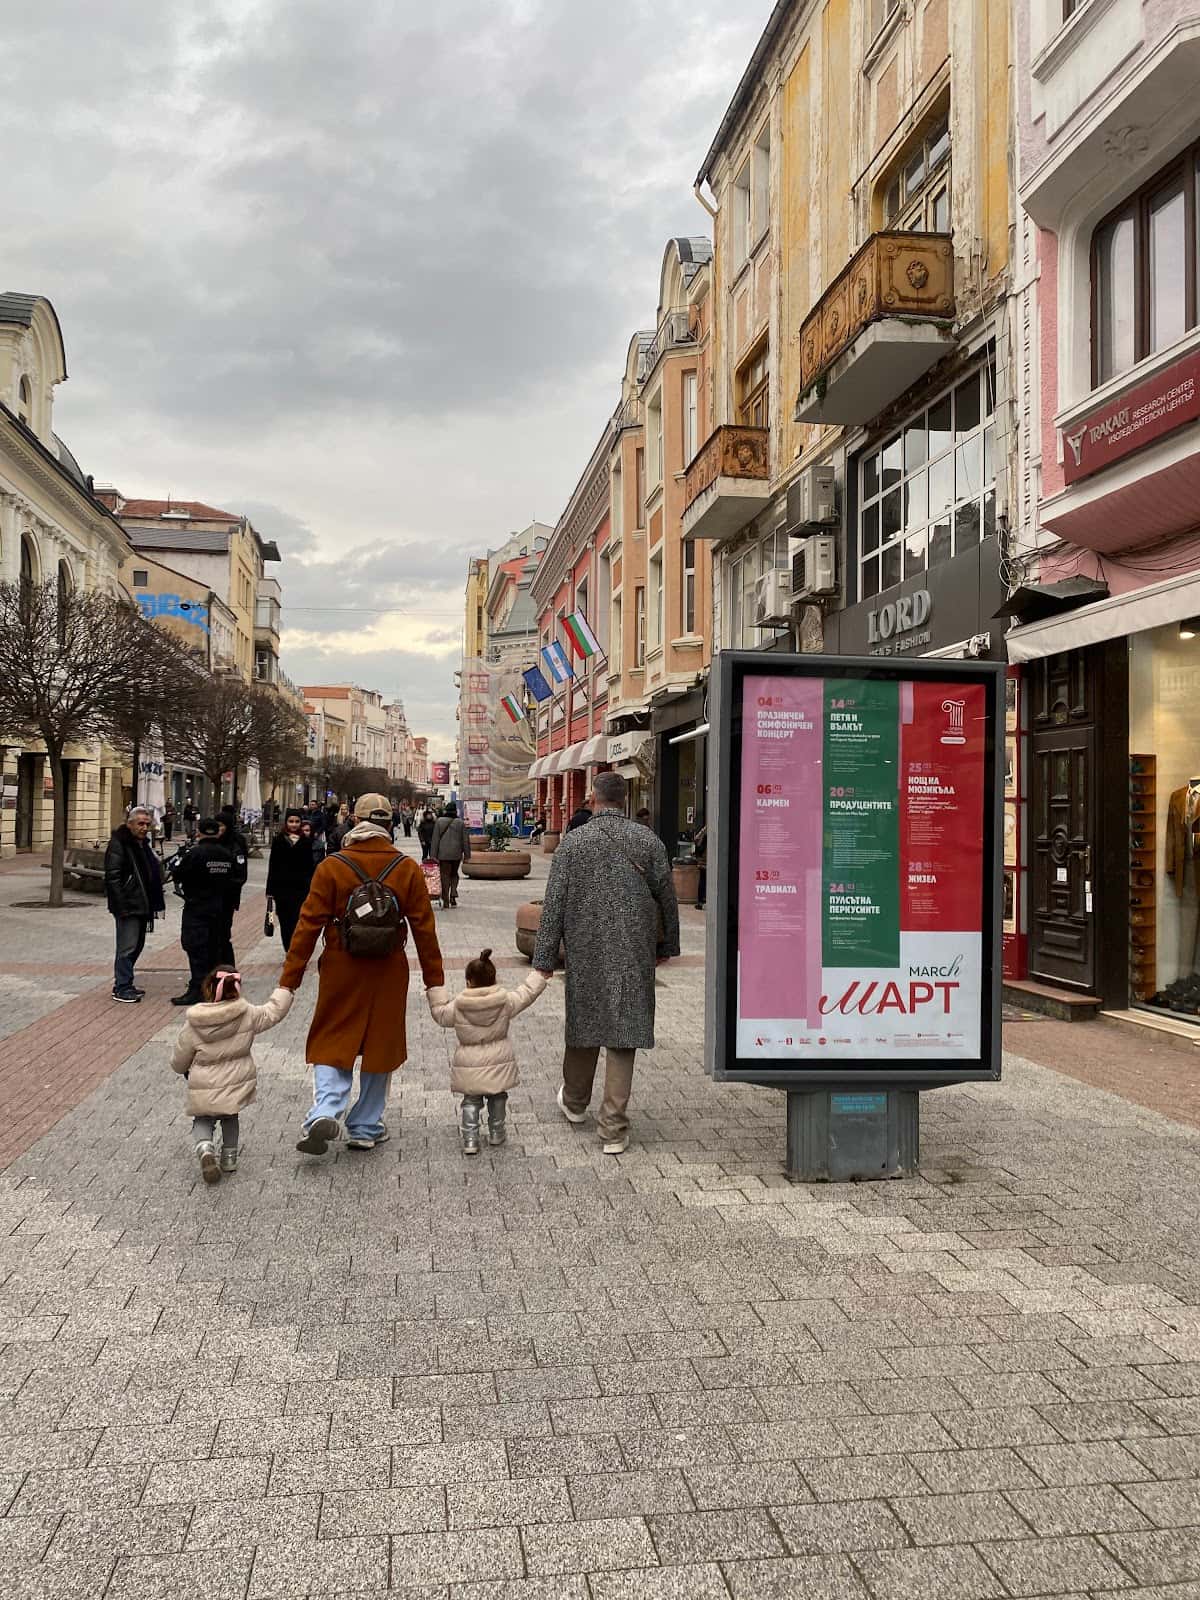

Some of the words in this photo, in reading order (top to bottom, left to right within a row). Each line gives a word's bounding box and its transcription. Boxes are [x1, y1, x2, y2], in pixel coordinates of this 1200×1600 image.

[1132, 394, 1167, 420] RESEARCH
[1166, 379, 1195, 400] CENTER
[1089, 407, 1130, 445] TRAKART
[868, 590, 931, 643] LORD
[895, 631, 931, 653] FASHION
[757, 697, 773, 706] 04
[831, 699, 845, 709] 14
[757, 711, 805, 720] ПРАЗНИЧЕН
[830, 713, 851, 721] ПЕТЯ
[830, 722, 864, 731] ВЪЛКЪТ
[757, 730, 794, 739] КОНЦЕРТ
[909, 763, 922, 773] 25
[908, 776, 927, 785] НОЩ
[757, 784, 772, 794] 06
[830, 787, 844, 797] 20
[908, 785, 955, 794] МЮЗИКЪЛА
[756, 799, 790, 807] КАРМЕН
[830, 800, 892, 810] ПРОДУЦЕНТИТЕ
[755, 870, 769, 880] 13
[908, 874, 936, 883] ЖИЗЕЛ
[755, 885, 797, 894] ТРАВИАТА
[829, 883, 845, 893] 24
[818, 981, 960, 1016] МАРТ
